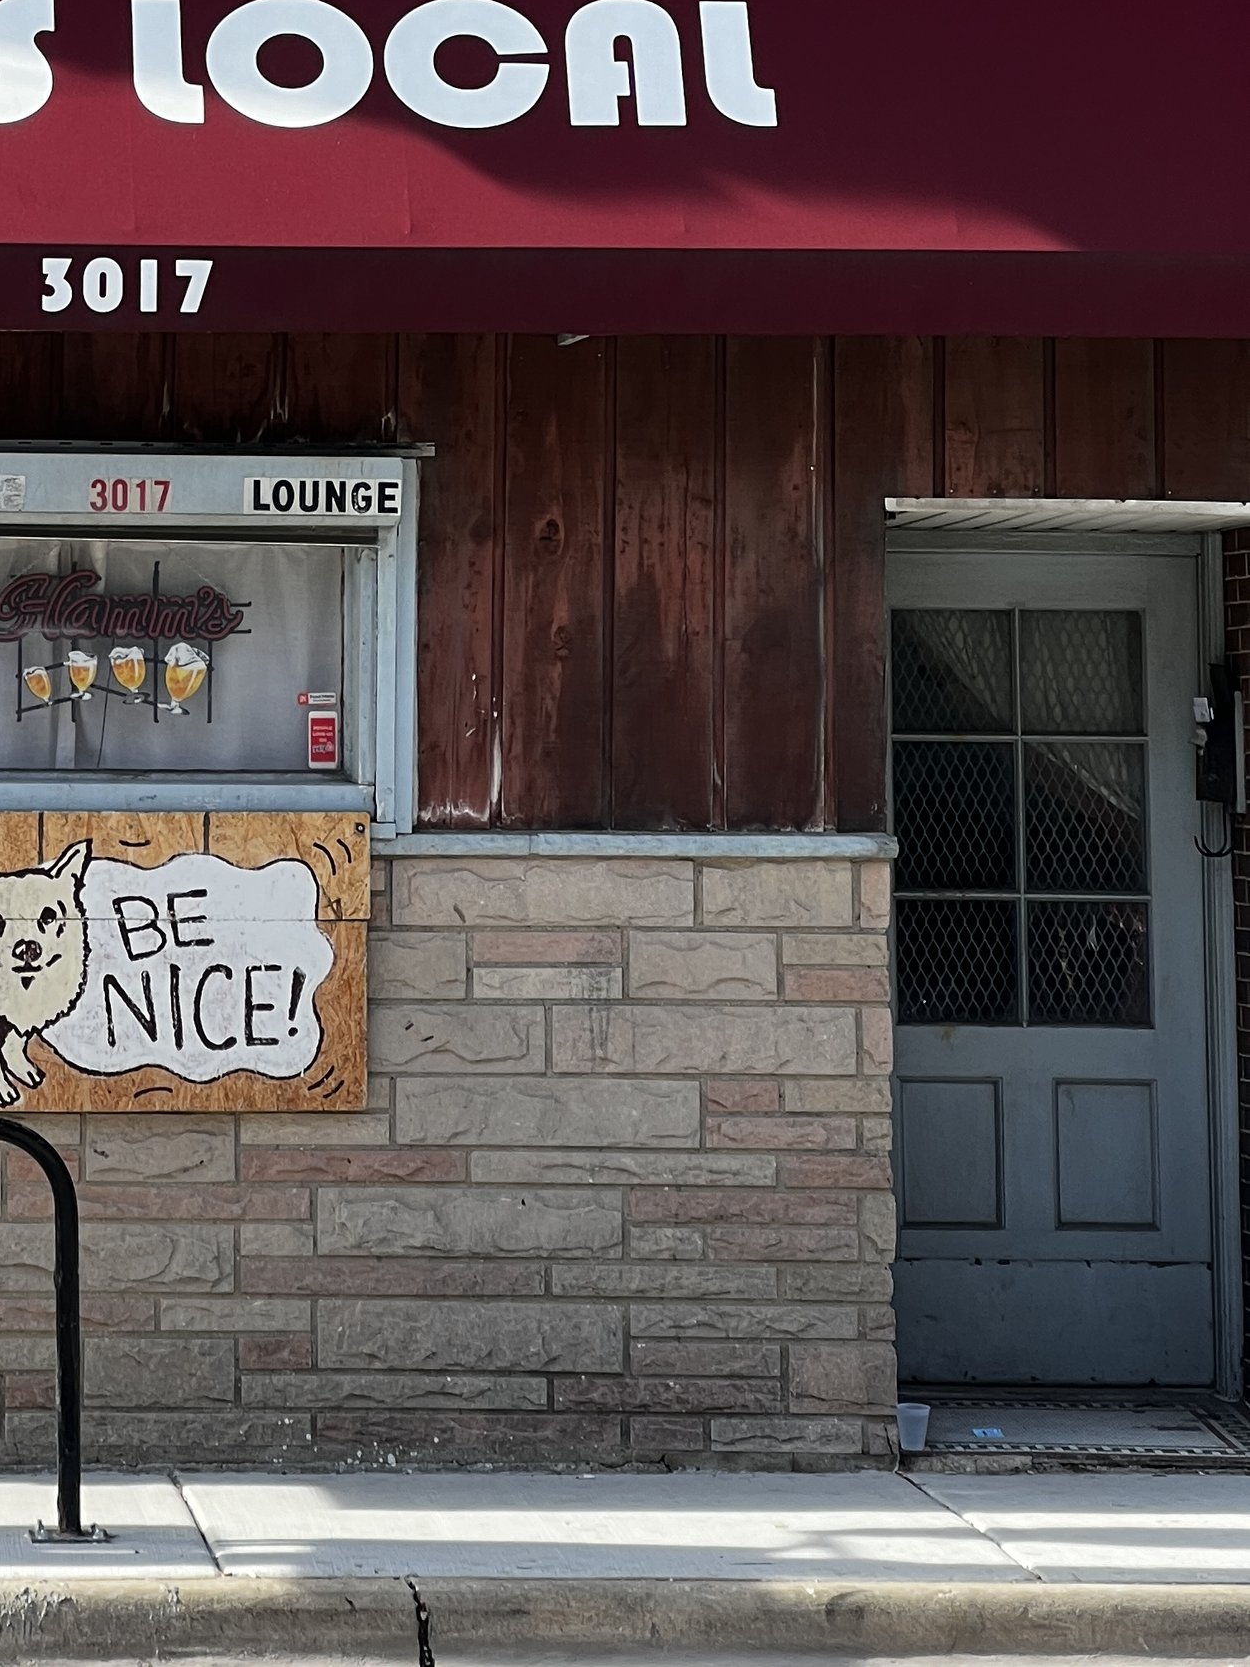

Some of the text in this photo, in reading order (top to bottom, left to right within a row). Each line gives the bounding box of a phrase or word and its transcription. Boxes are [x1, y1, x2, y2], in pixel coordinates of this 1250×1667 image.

[41, 256, 214, 314] 3017
[89, 478, 399, 515] 3017 LOUNGE
[111, 888, 215, 962] BE
[102, 963, 307, 1052] NICE!
